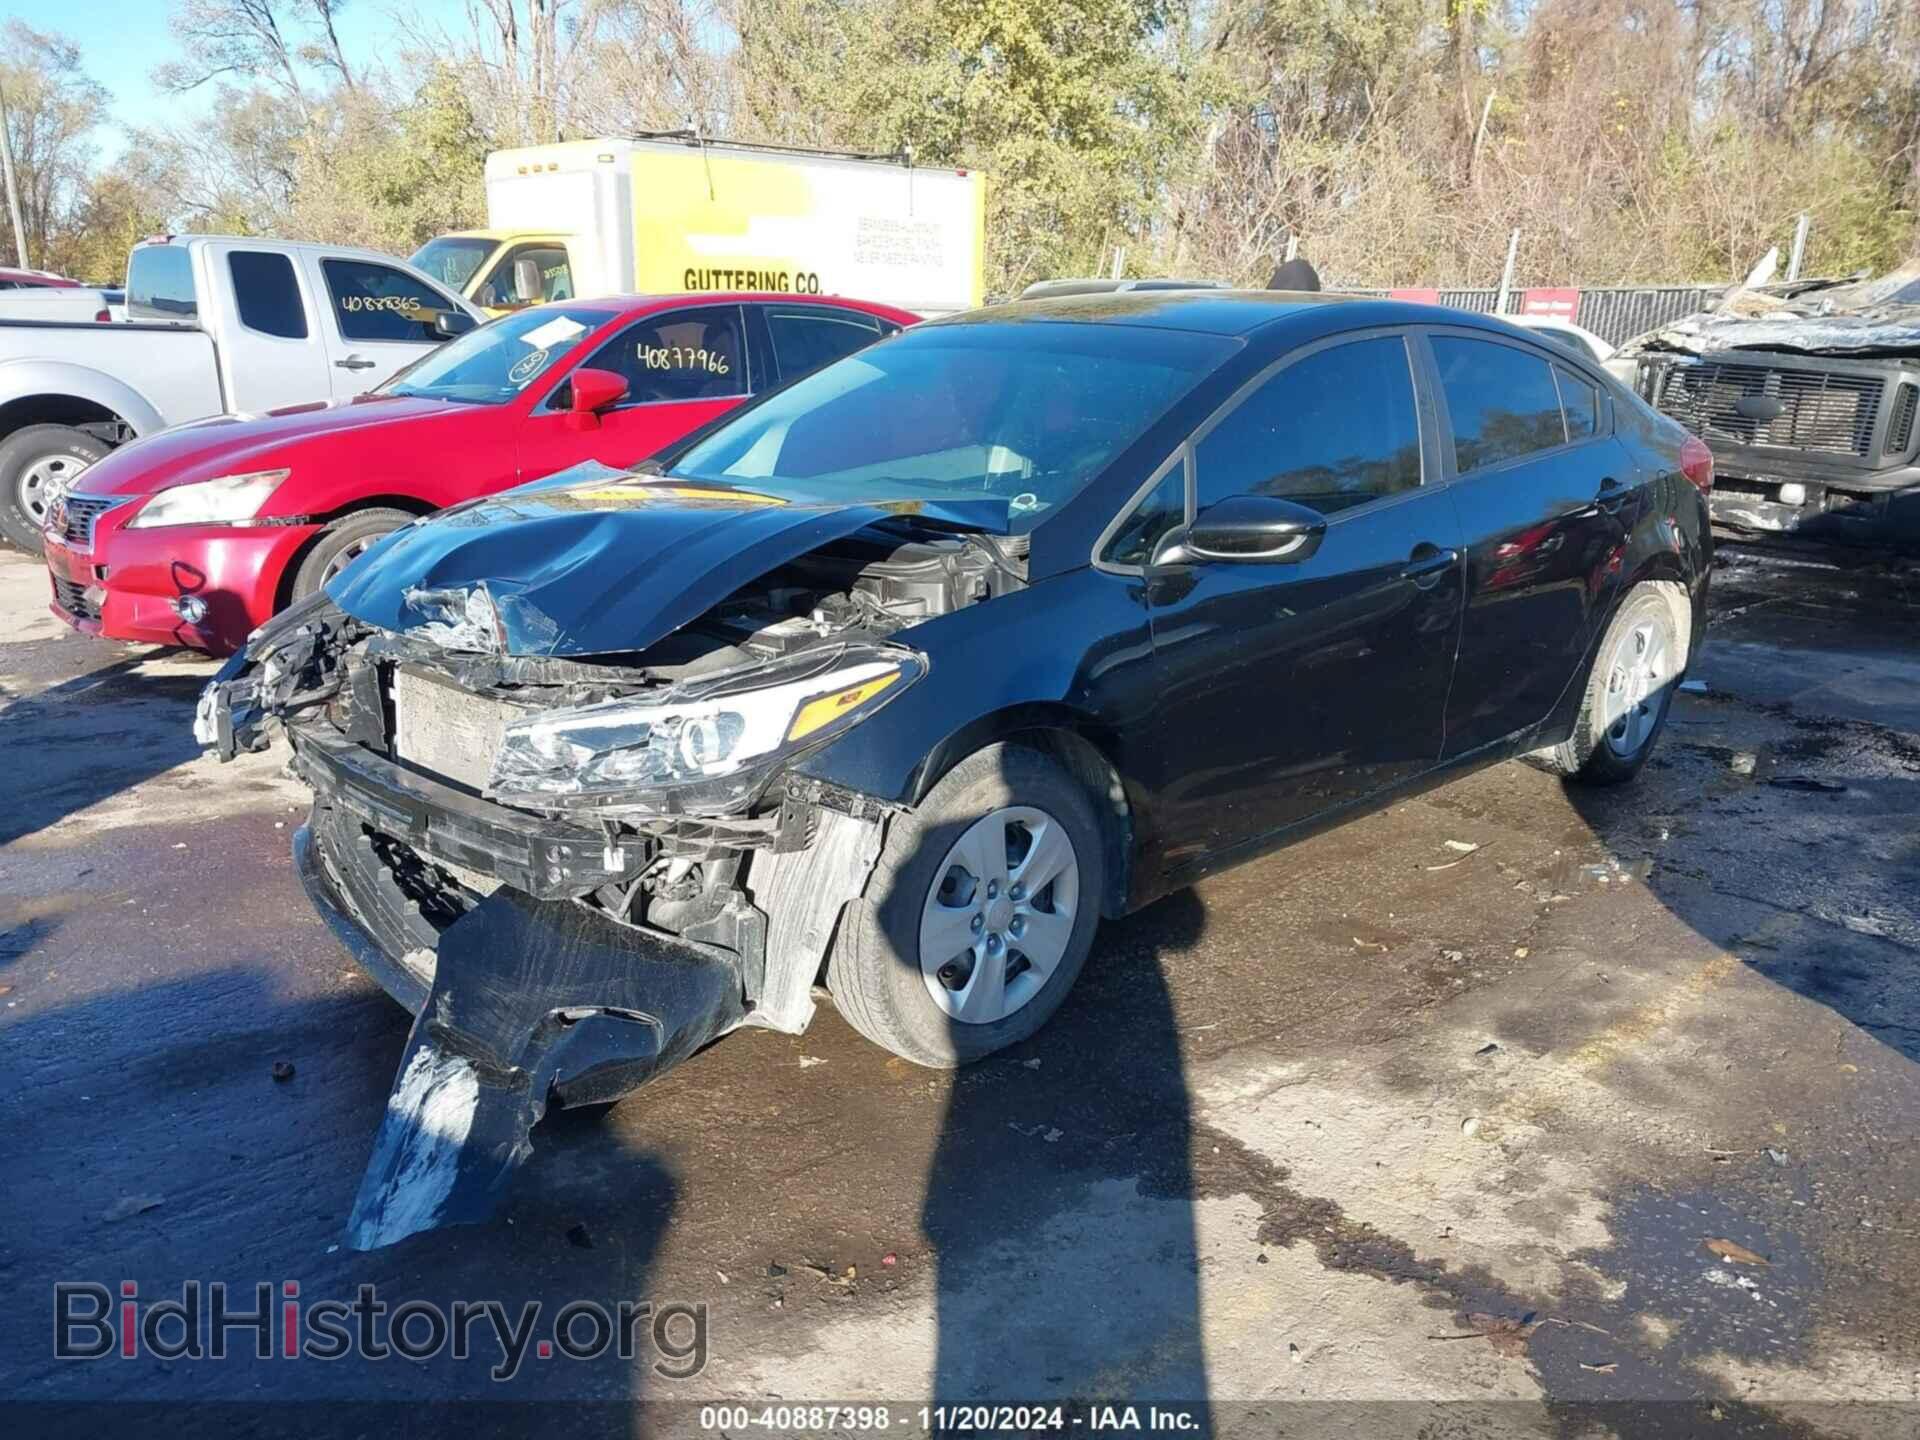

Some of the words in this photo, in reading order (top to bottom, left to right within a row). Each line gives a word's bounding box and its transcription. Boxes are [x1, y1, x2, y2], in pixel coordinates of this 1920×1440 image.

[684, 268, 789, 292] GUTTERING
[795, 272, 824, 295] CO.
[342, 296, 421, 312] 40888365
[637, 343, 729, 375] 40877966
